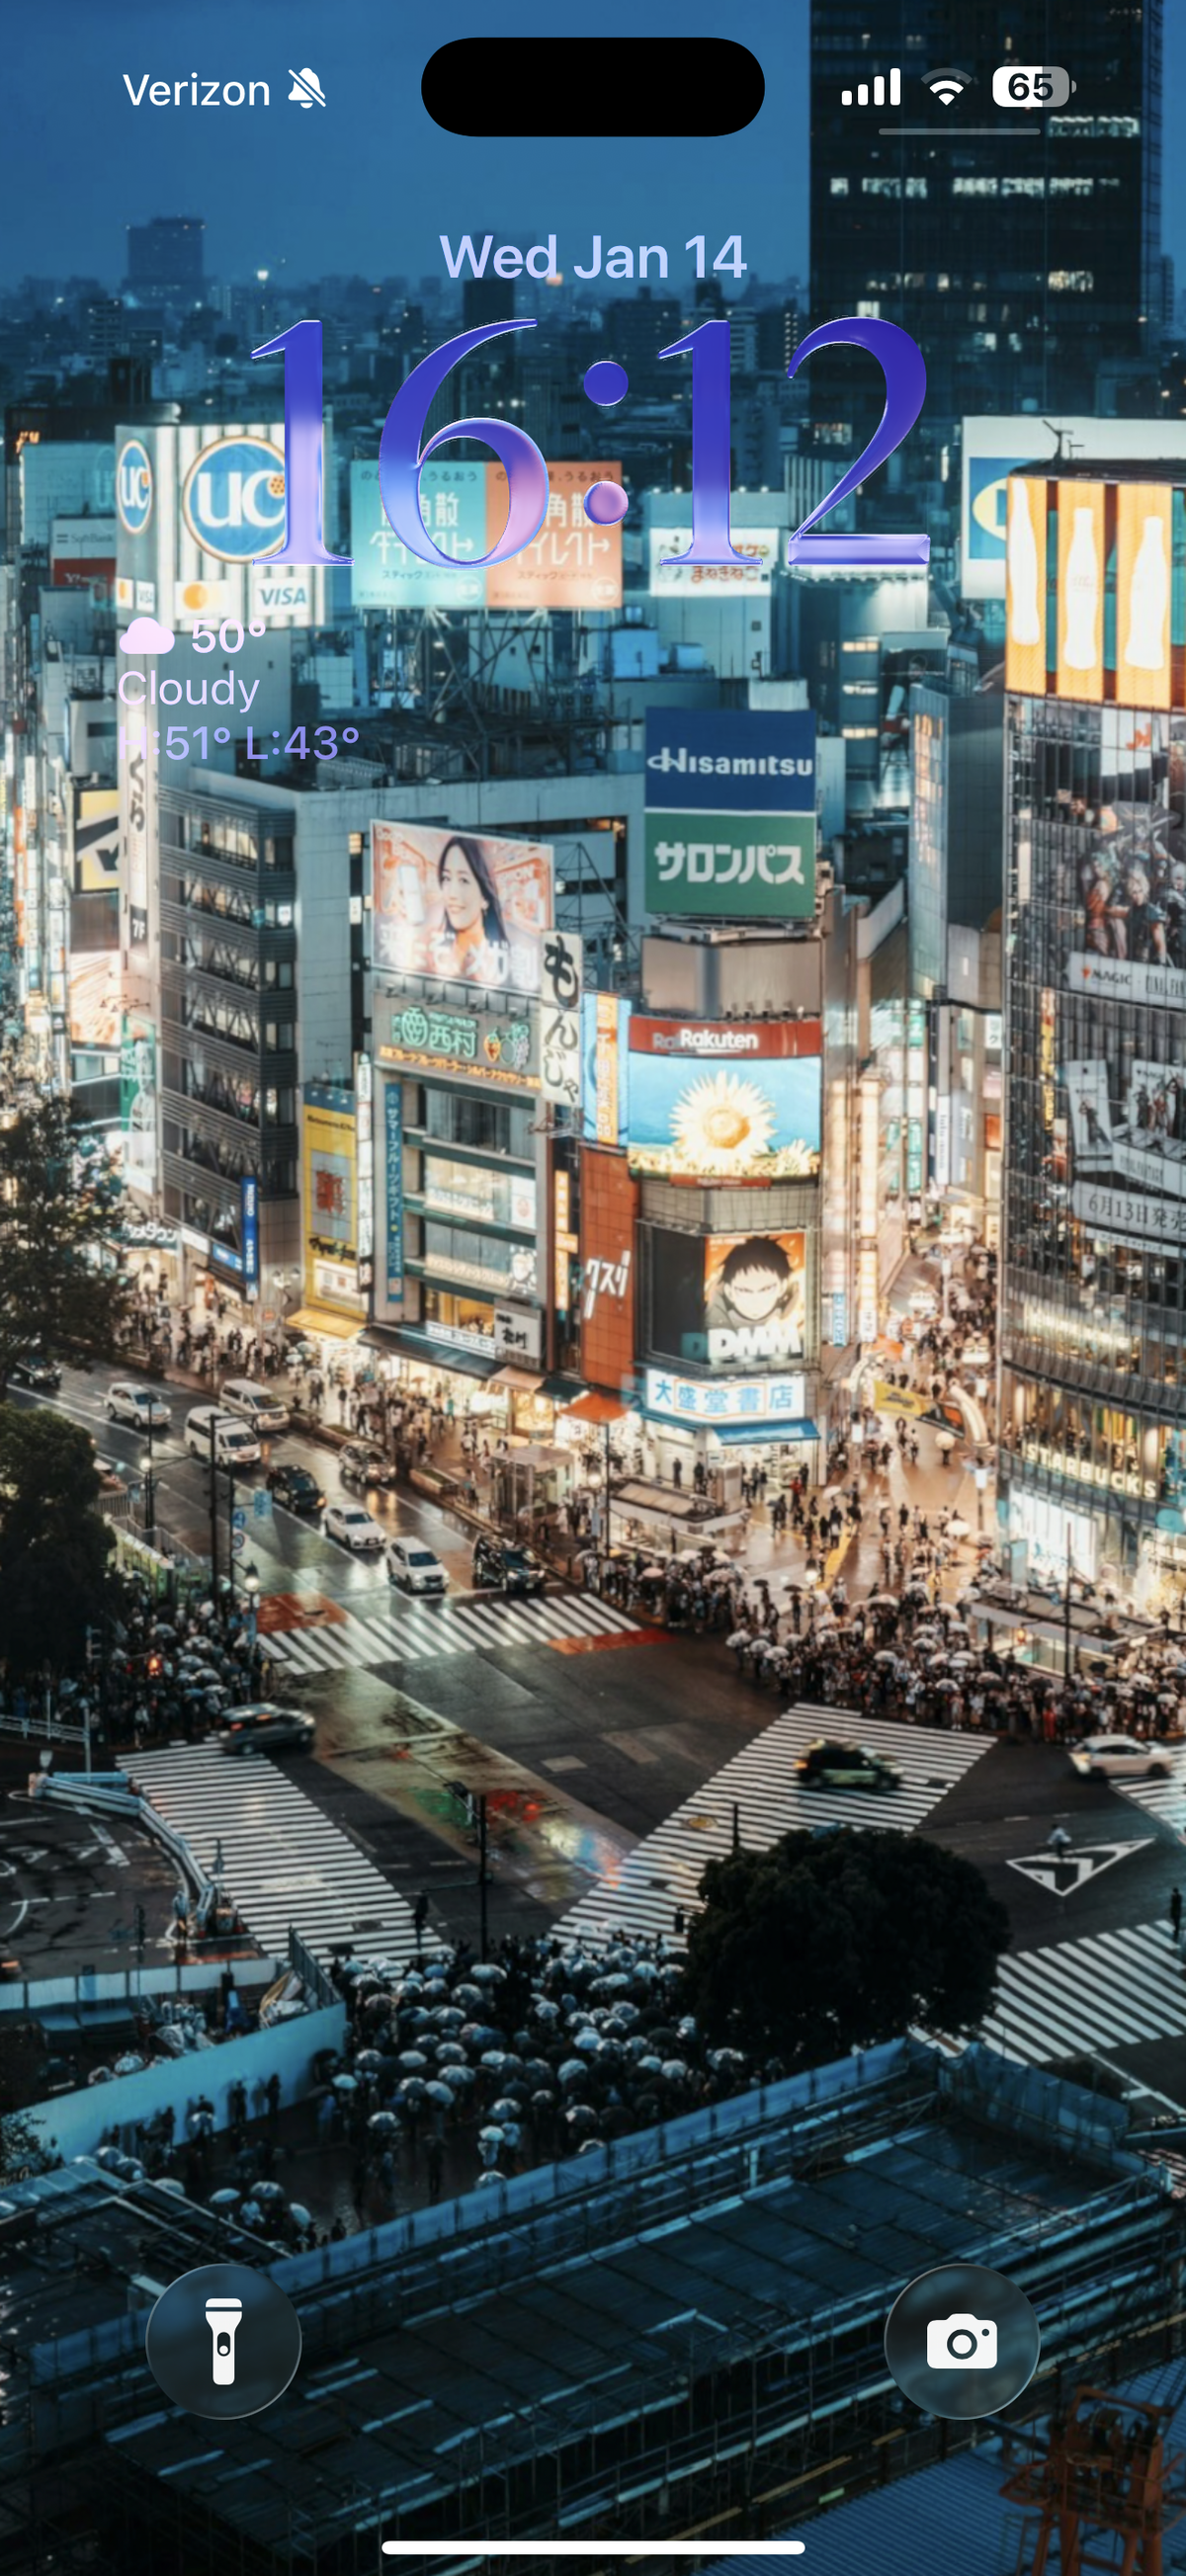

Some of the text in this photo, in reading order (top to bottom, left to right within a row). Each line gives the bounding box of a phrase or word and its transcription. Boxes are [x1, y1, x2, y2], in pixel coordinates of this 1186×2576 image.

[259, 586, 307, 607] VISA
[646, 747, 813, 776] Hisamitsu
[654, 842, 805, 885] サロンパス
[131, 919, 145, 940] 7F
[544, 934, 579, 1104] もんじゃ
[429, 1023, 476, 1059] 西村
[680, 1028, 759, 1050] Rakuten
[1088, 1193, 1186, 1233] 6月13日発売
[708, 1323, 803, 1366] DMM
[654, 1378, 795, 1414] 大盛堂書店
[1025, 1442, 1157, 1500] STARBUCKS
